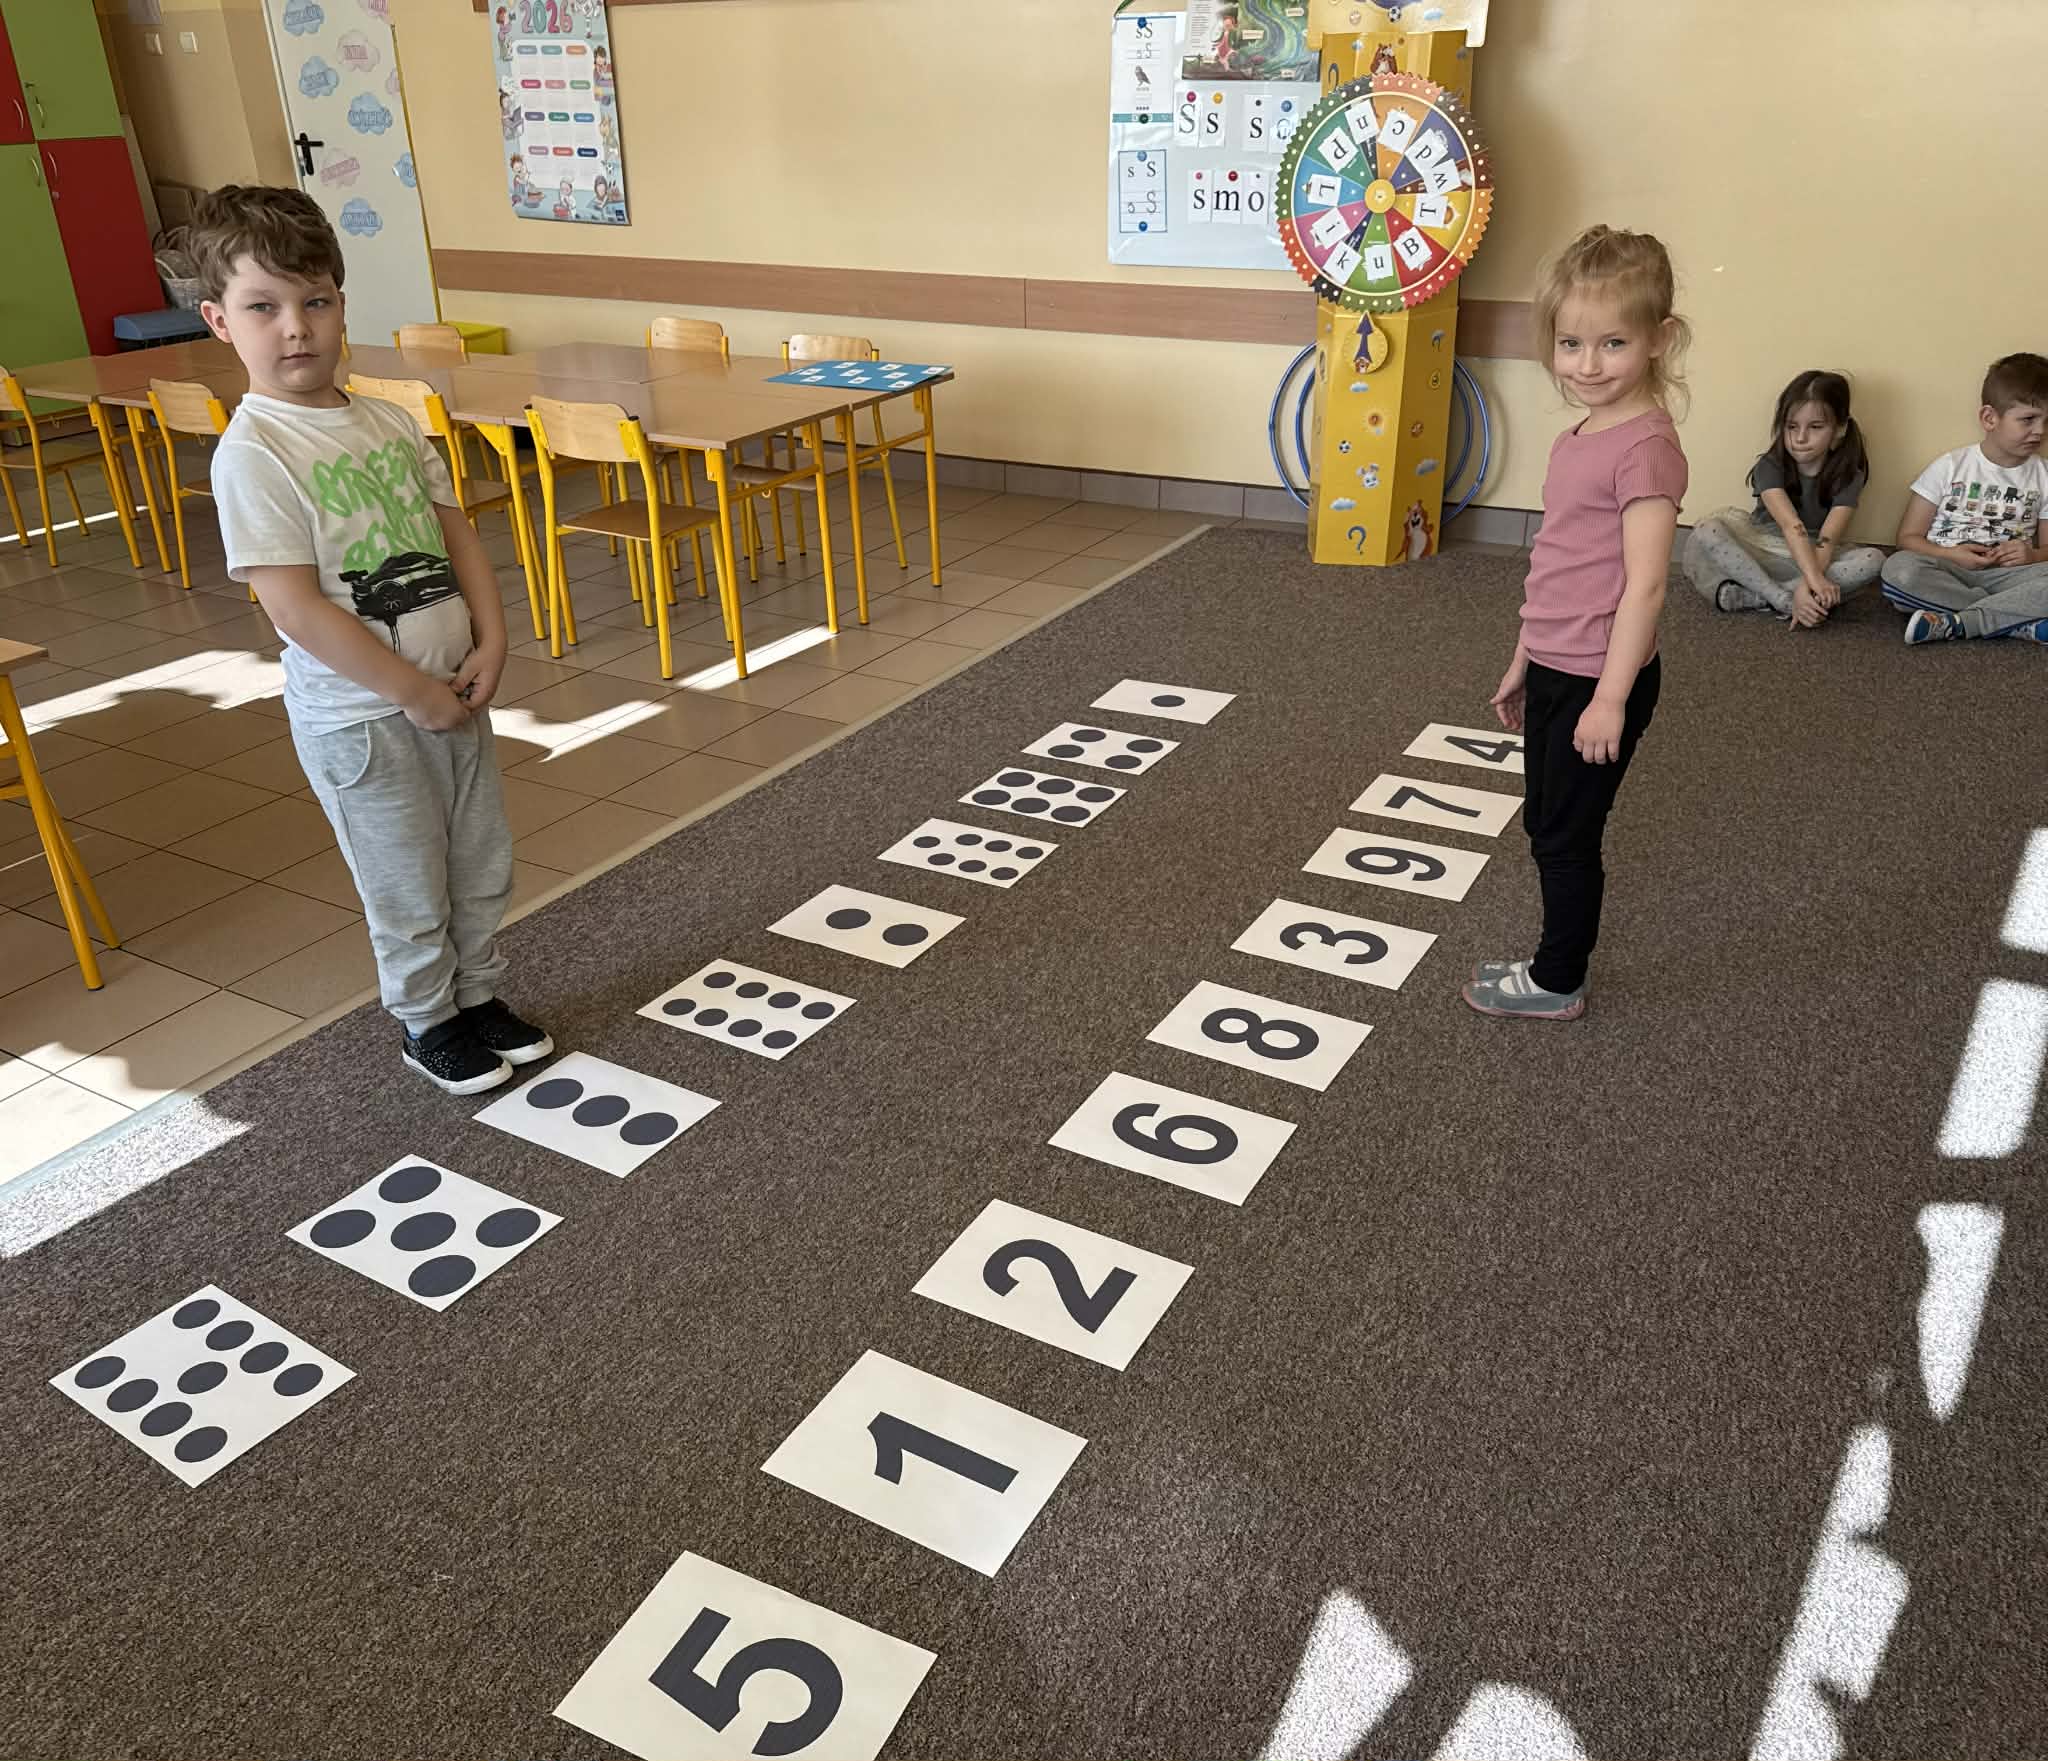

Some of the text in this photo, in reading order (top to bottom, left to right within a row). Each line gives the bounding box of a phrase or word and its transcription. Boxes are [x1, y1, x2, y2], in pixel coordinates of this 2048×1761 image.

[519, 0, 573, 33] 2026
[1402, 237, 1420, 256] B
[1443, 735, 1524, 763] 4
[1384, 785, 1482, 819] 7
[1345, 846, 1447, 881] 9
[1279, 921, 1389, 965] 3
[1201, 1007, 1320, 1060] 8
[1112, 1102, 1239, 1164] 6
[982, 1238, 1138, 1334] 2
[867, 1410, 1020, 1494] 1
[648, 1606, 843, 1757] 5
